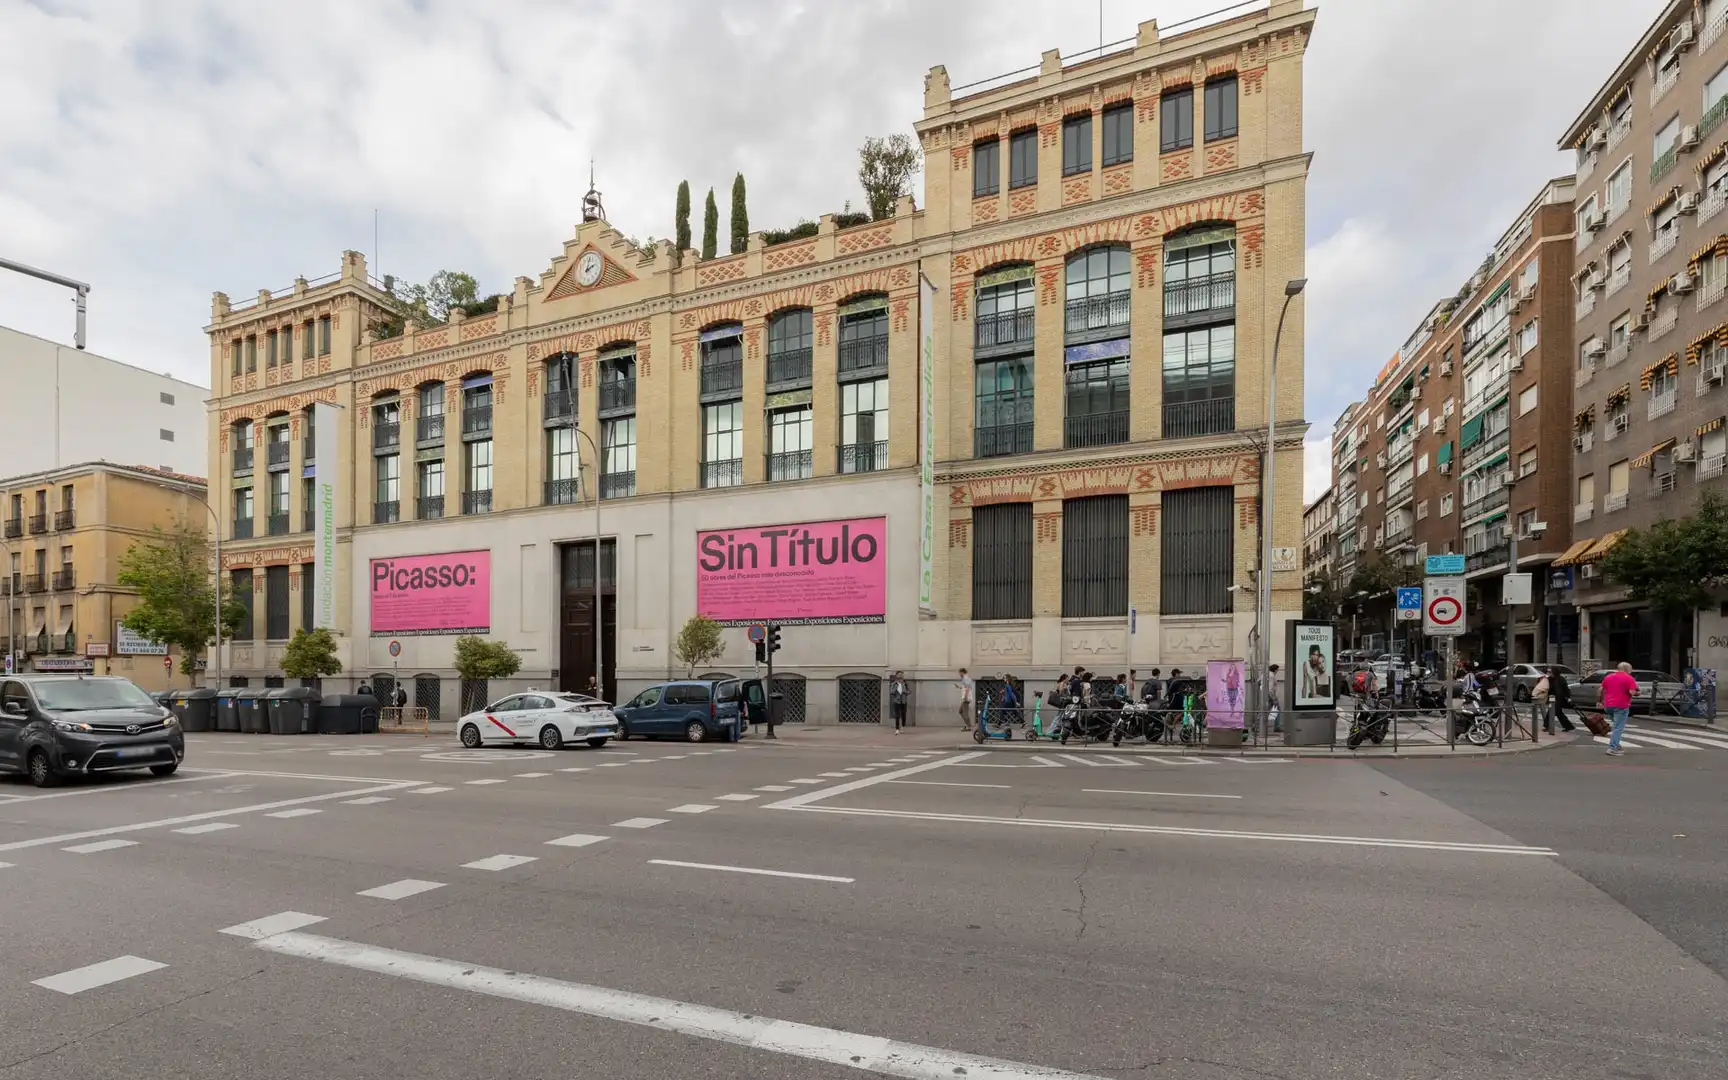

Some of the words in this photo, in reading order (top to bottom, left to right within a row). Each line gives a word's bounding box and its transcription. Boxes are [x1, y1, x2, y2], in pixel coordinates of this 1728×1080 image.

[923, 336, 932, 485] Encendida
[321, 483, 332, 567] montemadrid
[923, 495, 932, 561] Casa
[700, 534, 758, 572] Sin
[760, 524, 877, 567] Título
[373, 562, 476, 592] Picasso:
[727, 572, 737, 580] del
[737, 571, 760, 579] Picasso
[774, 568, 815, 577] desconocido
[921, 570, 931, 602] La
[731, 618, 767, 627] Exposiciones
[767, 617, 804, 626] Exposiciones
[804, 616, 843, 626] Exposiciones
[843, 614, 883, 624] Exposiciones
[1300, 634, 1328, 642] MANIFESTO
